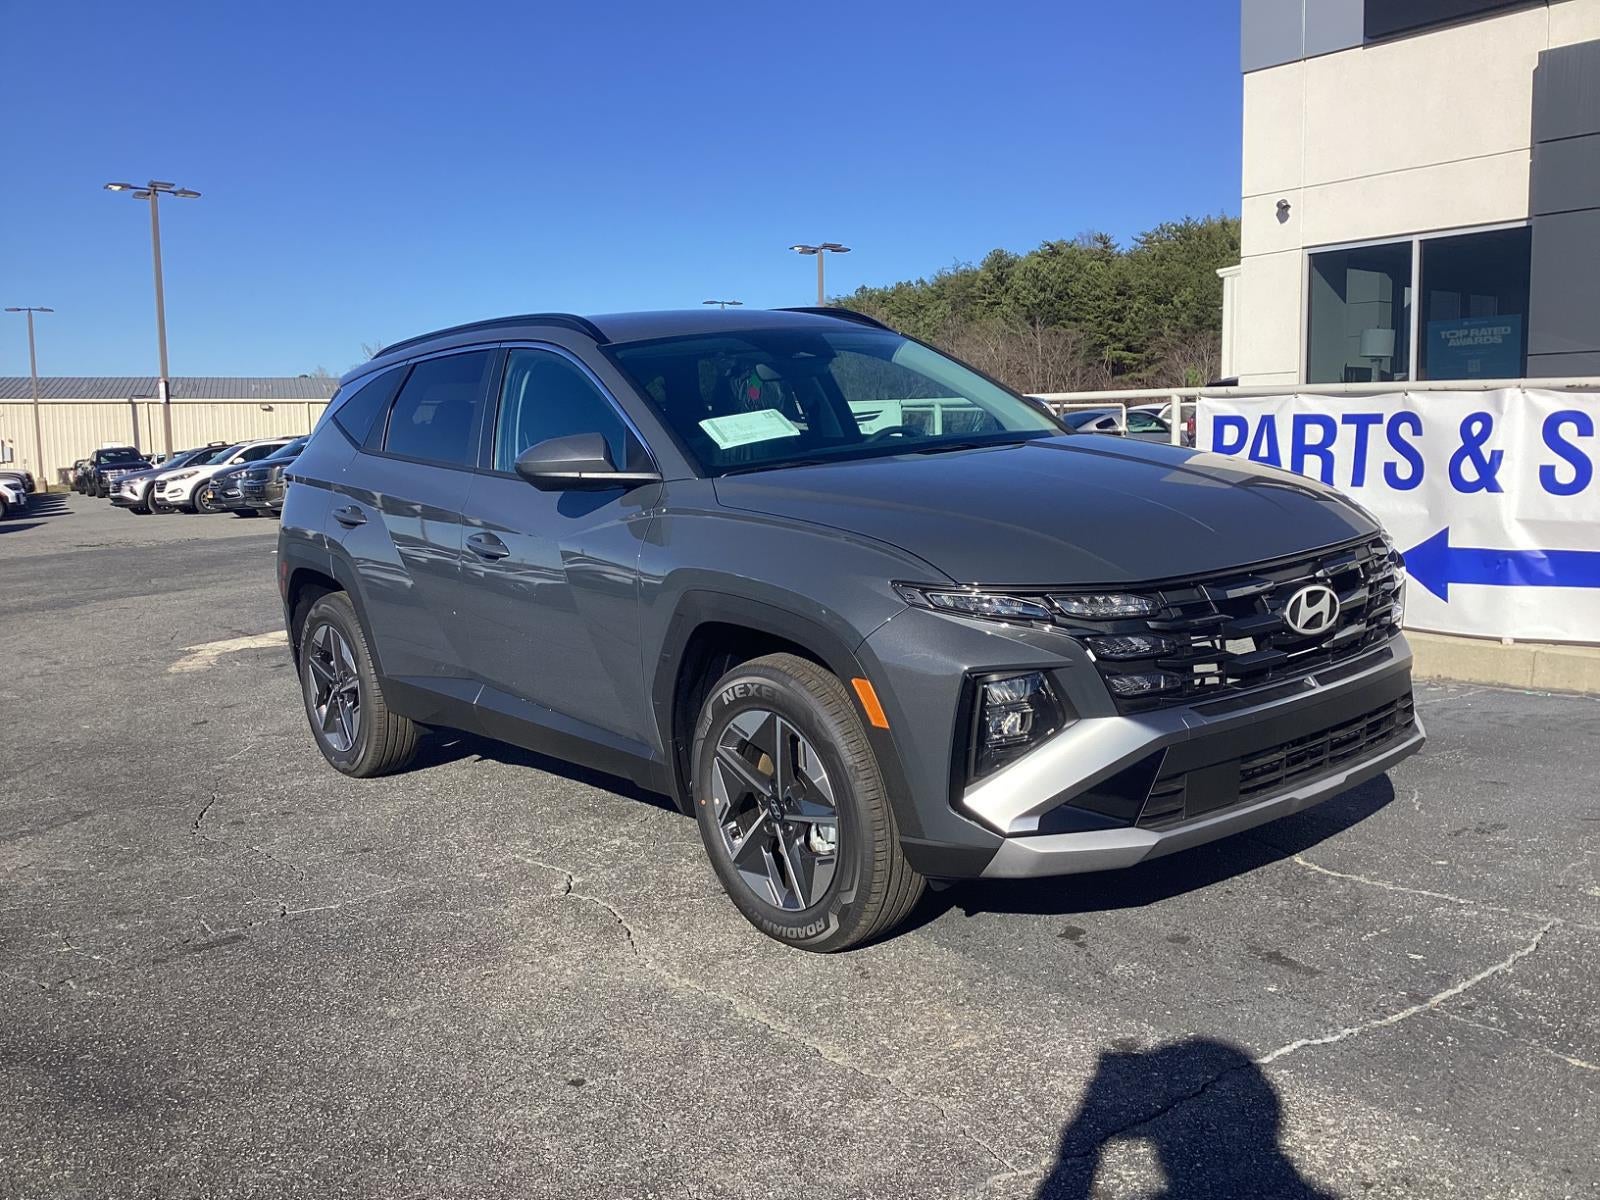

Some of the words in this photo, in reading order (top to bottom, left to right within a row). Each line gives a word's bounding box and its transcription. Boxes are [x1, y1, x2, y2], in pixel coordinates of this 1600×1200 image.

[1440, 329, 1469, 340] TOP
[1470, 326, 1512, 337] RATED
[1448, 335, 1503, 347] AWARDS
[1211, 411, 1424, 491] PARTS
[1449, 412, 1504, 494] &
[1539, 410, 1595, 496] S
[721, 683, 781, 705] NEXE
